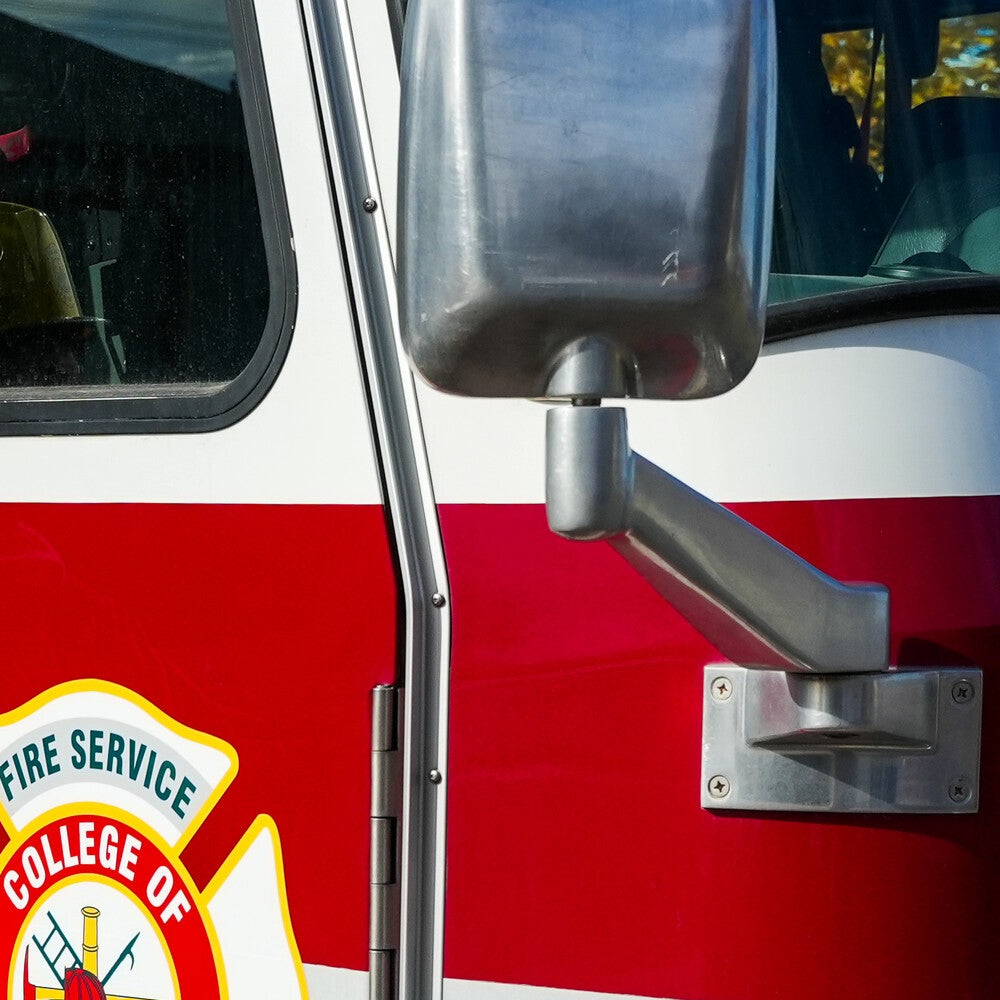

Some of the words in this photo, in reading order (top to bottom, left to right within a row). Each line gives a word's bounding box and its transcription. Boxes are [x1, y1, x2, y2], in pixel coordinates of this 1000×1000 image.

[70, 728, 197, 820] SERVICE
[3, 821, 142, 910] COLLEGE
[146, 865, 192, 924] OF
